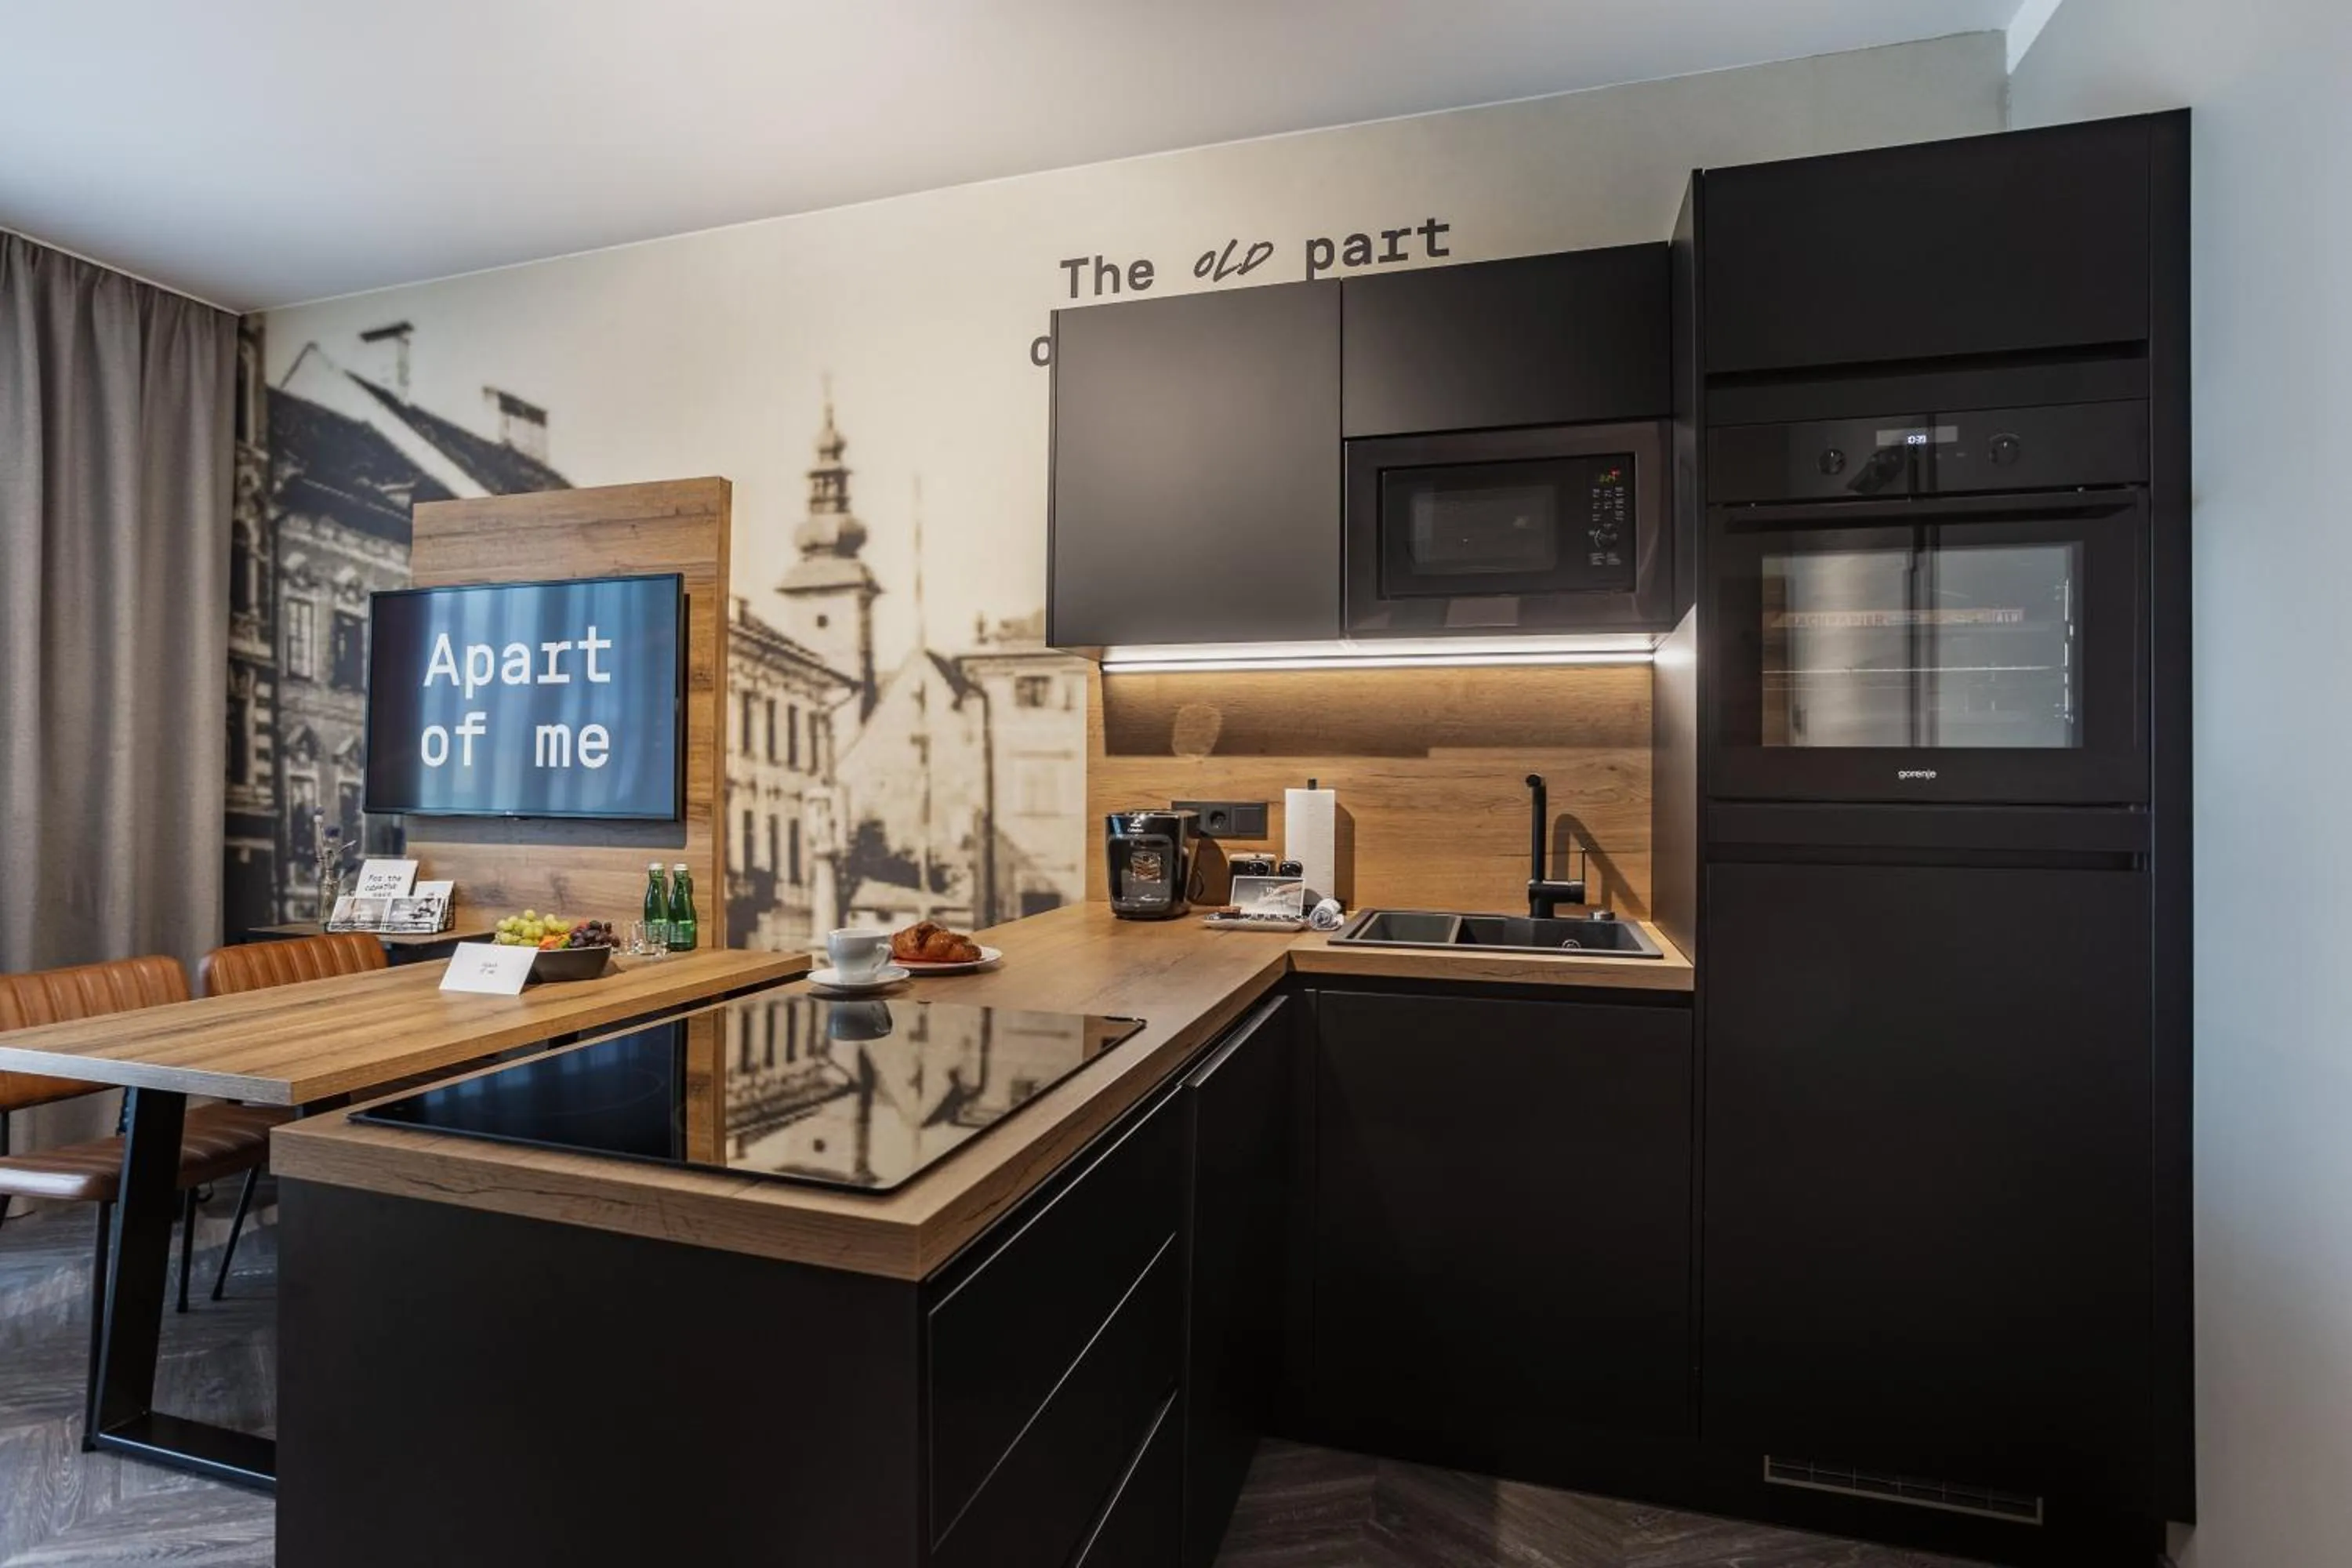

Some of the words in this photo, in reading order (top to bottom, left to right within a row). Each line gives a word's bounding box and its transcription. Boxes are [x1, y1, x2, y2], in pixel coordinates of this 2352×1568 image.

[1061, 255, 1155, 299] The
[1306, 217, 1450, 281] part
[424, 626, 612, 700] Apart
[421, 711, 486, 768] of
[535, 724, 609, 769] me
[1898, 769, 1937, 780] gorenje
